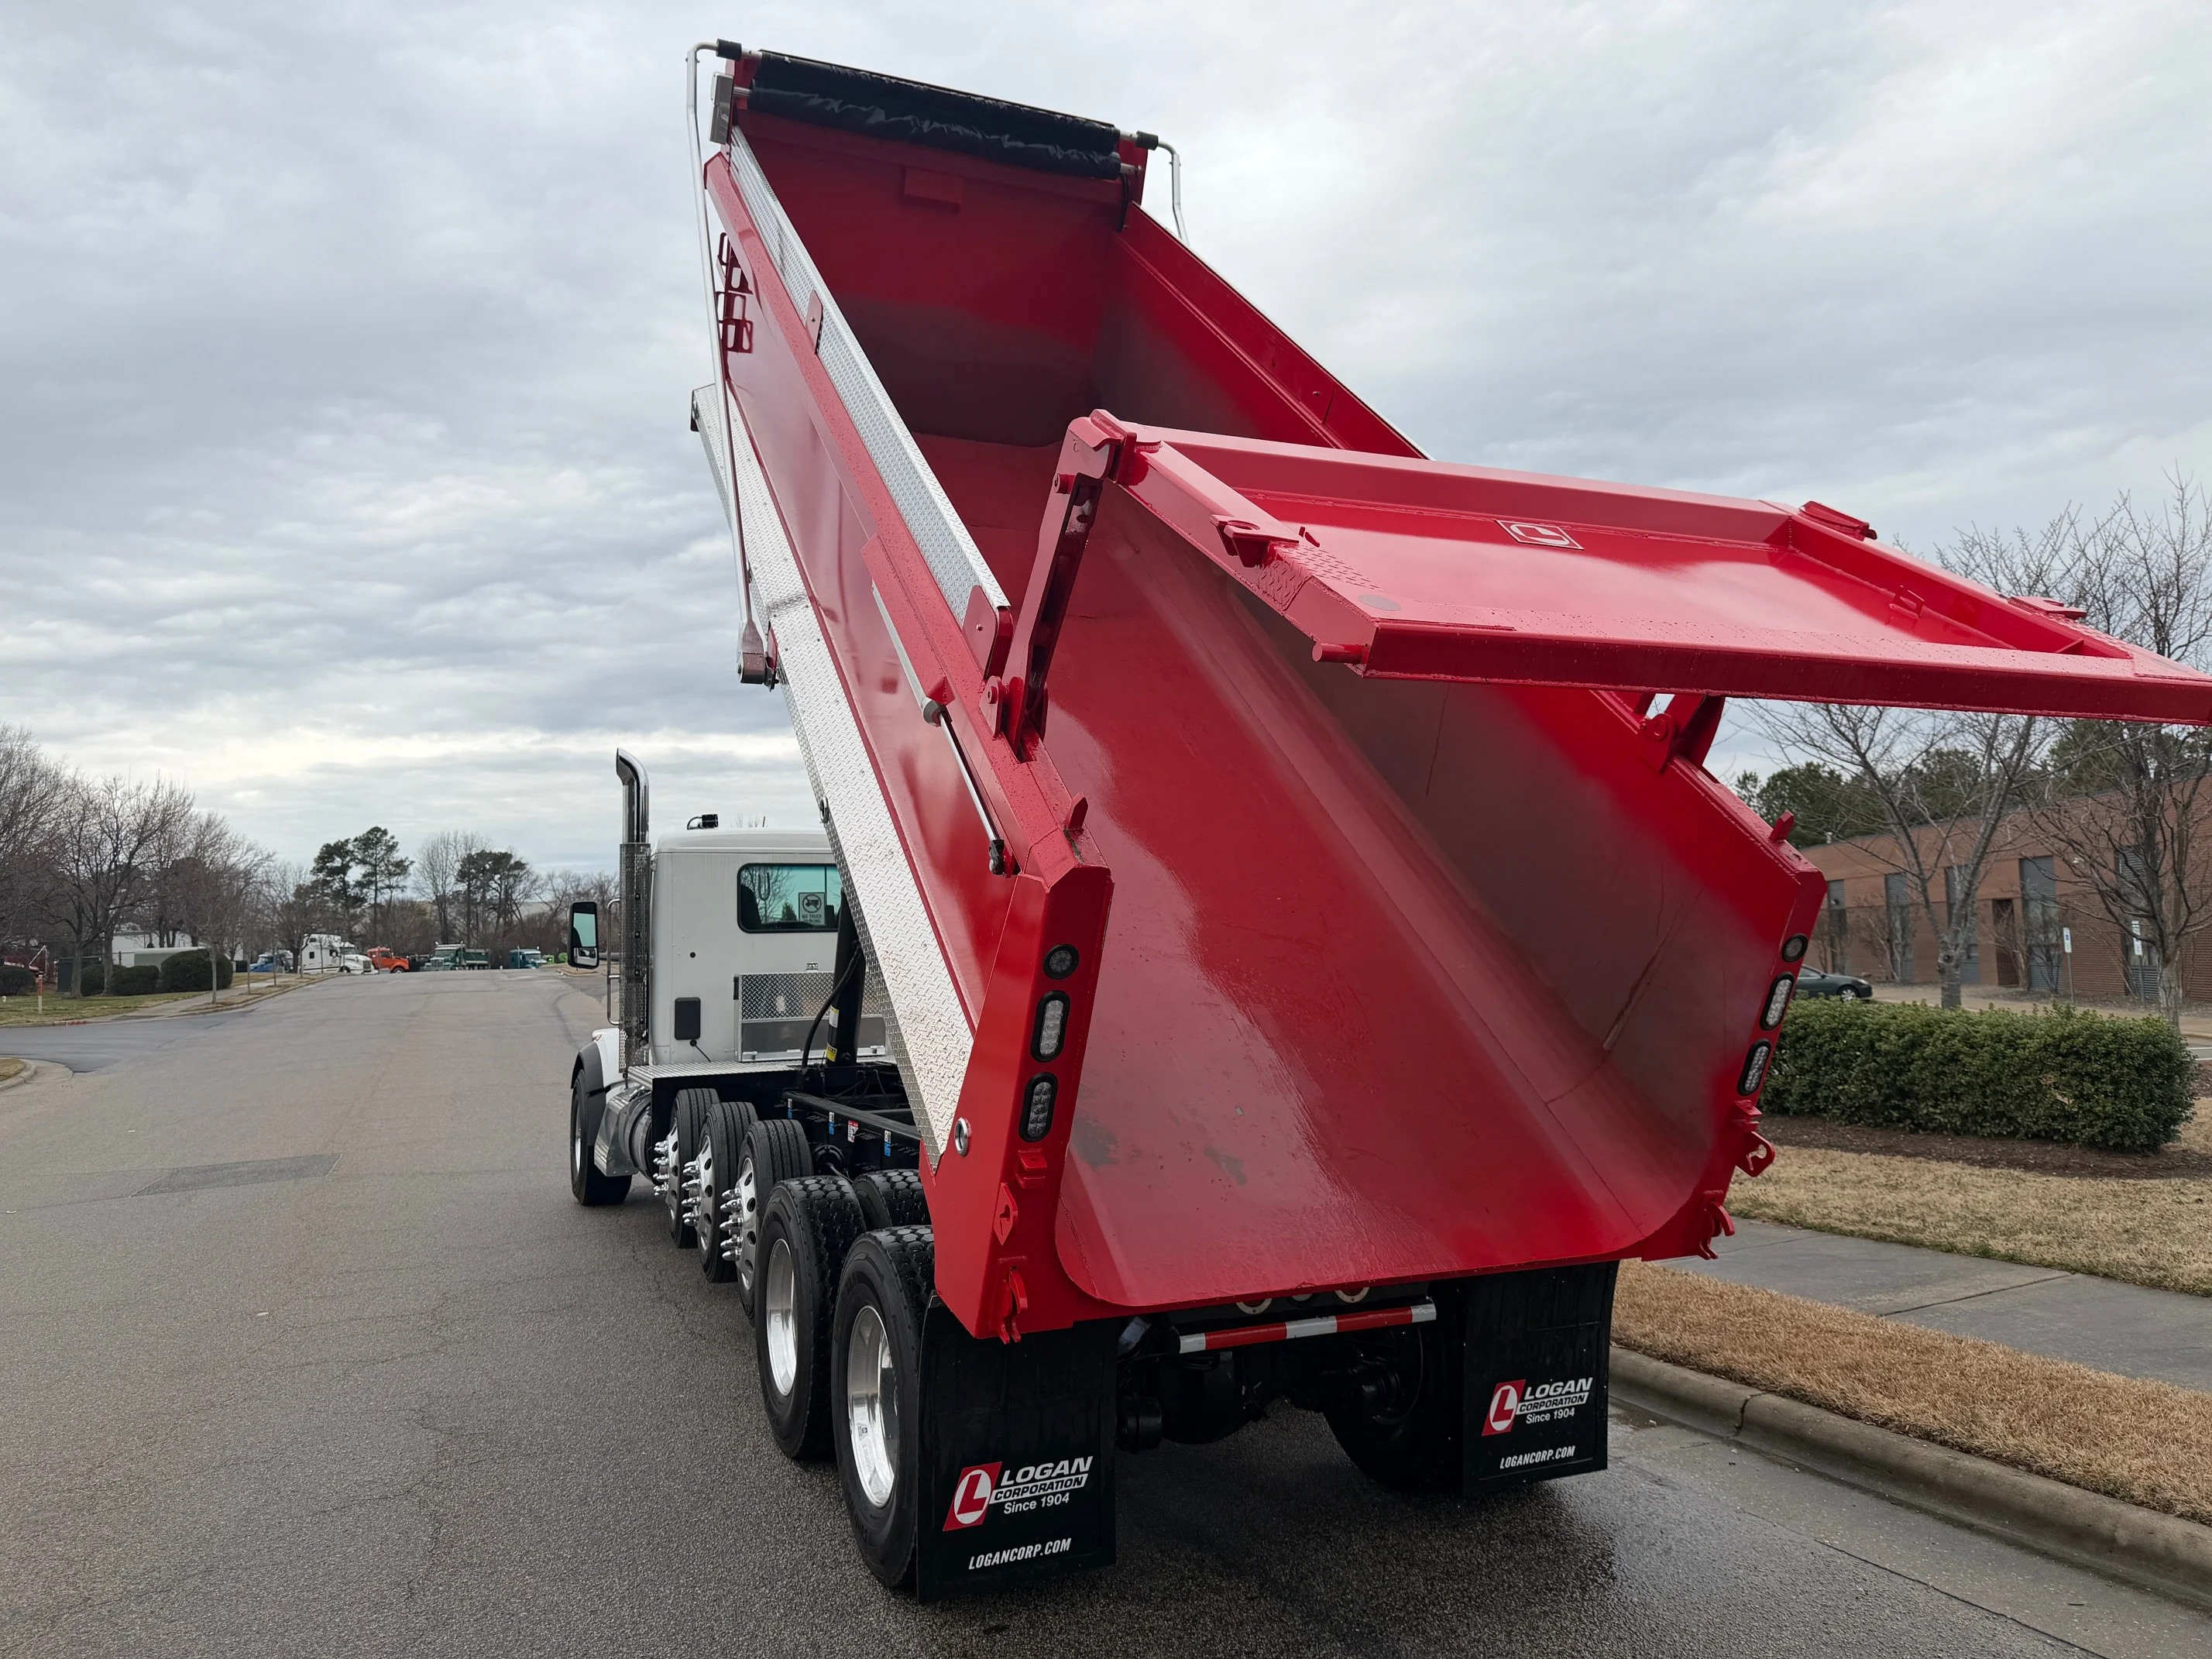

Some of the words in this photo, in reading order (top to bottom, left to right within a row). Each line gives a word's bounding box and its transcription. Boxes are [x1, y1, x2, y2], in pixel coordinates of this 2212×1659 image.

[1523, 1377, 1593, 1400] LOGAN
[1519, 1393, 1586, 1412] CORPORATION
[1526, 1413, 1551, 1424] Since
[1554, 1407, 1575, 1420] 1904
[1499, 1445, 1576, 1469] LOGANCORP.COM
[1000, 1456, 1094, 1486] LOGAN
[994, 1475, 1085, 1500] CORPORATION
[1003, 1501, 1036, 1515] Since
[1041, 1492, 1070, 1508] 1904
[968, 1537, 1072, 1570] LOGANCORP.COM
